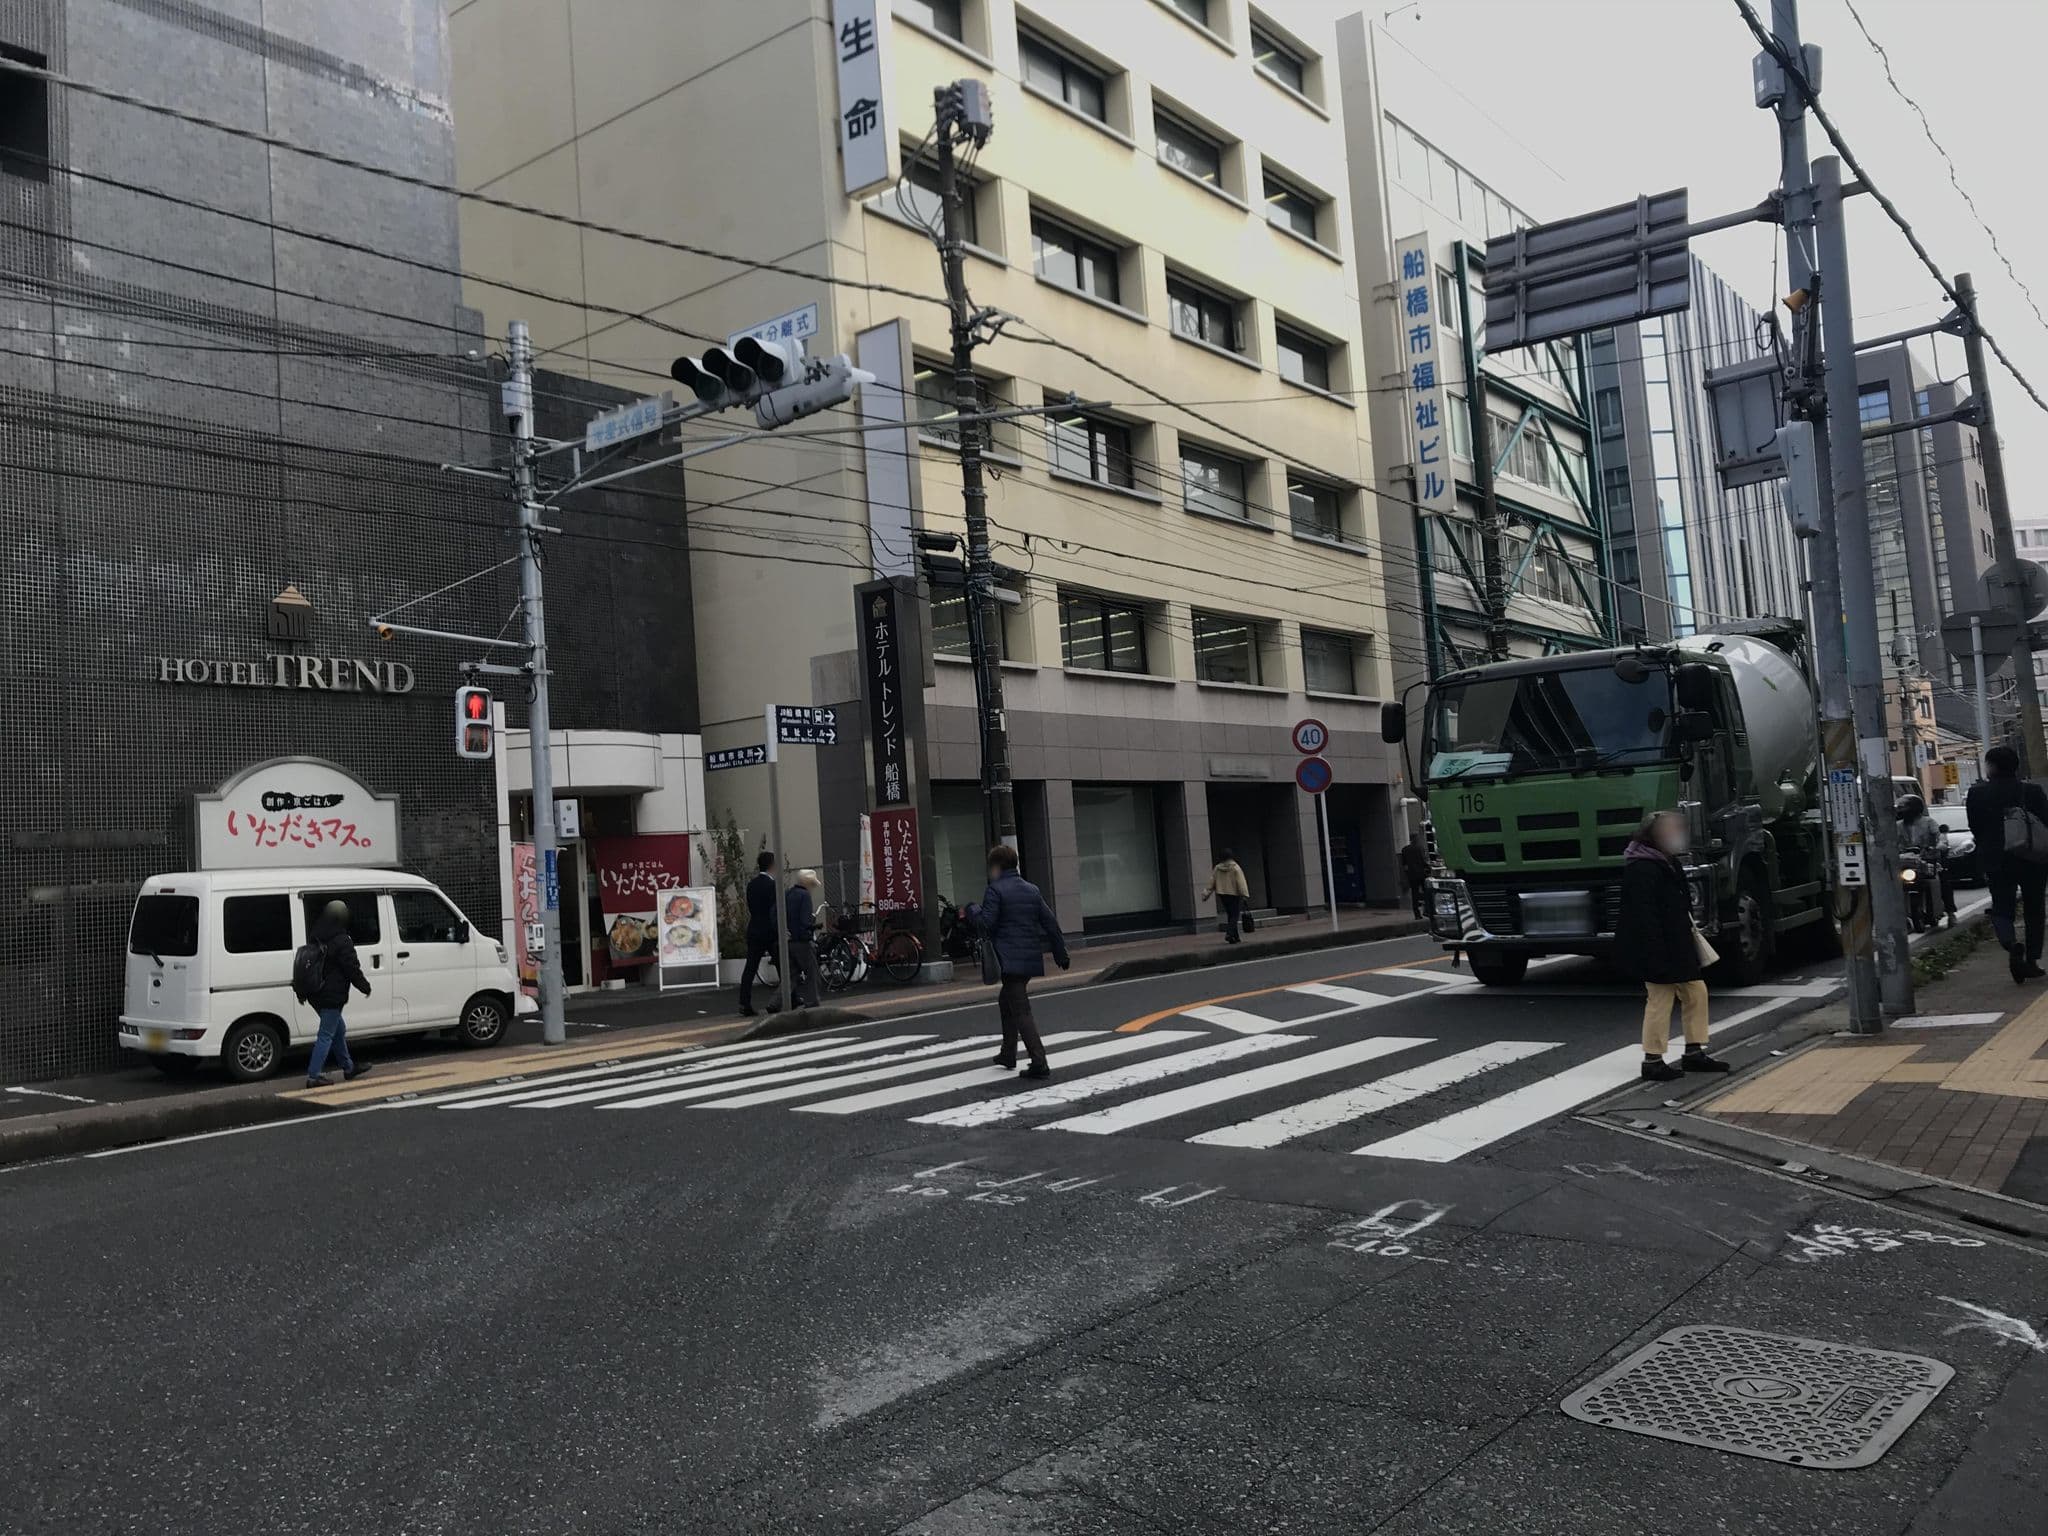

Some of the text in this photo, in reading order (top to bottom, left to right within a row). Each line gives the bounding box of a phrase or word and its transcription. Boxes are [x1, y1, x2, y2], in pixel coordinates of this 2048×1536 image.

[840, 16, 878, 139] 生命
[1403, 248, 1445, 500] 船橋市福祉ビル
[159, 653, 415, 693] HOTEL TREND
[1301, 728, 1320, 745] 40
[1458, 793, 1484, 813] 116
[228, 810, 371, 848] いただきマス。
